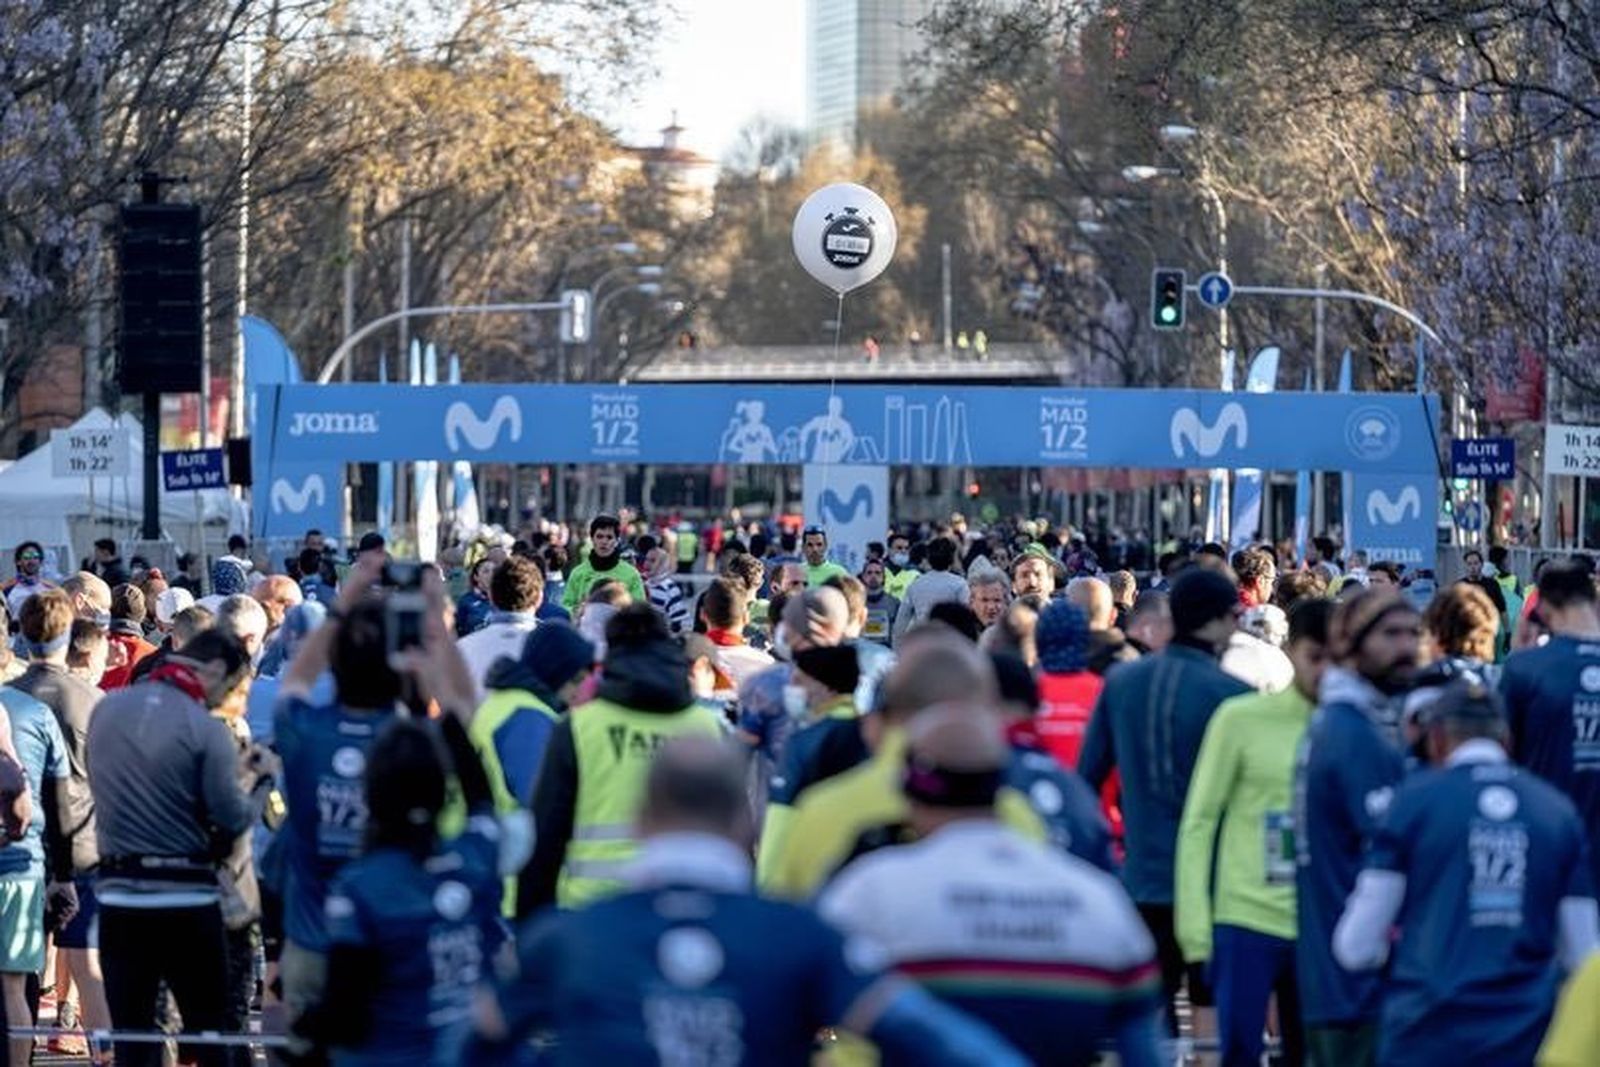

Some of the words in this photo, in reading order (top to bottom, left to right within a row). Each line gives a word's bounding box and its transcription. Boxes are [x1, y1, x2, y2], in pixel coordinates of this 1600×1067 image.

[592, 403, 639, 419] MAD
[1040, 407, 1087, 424] MAD
[592, 420, 638, 445] 1/2
[1040, 425, 1087, 449] 1/2
[1564, 431, 1581, 447] 1h
[69, 436, 86, 449] 1h
[69, 457, 86, 471] 1h
[1562, 456, 1579, 469] 1h
